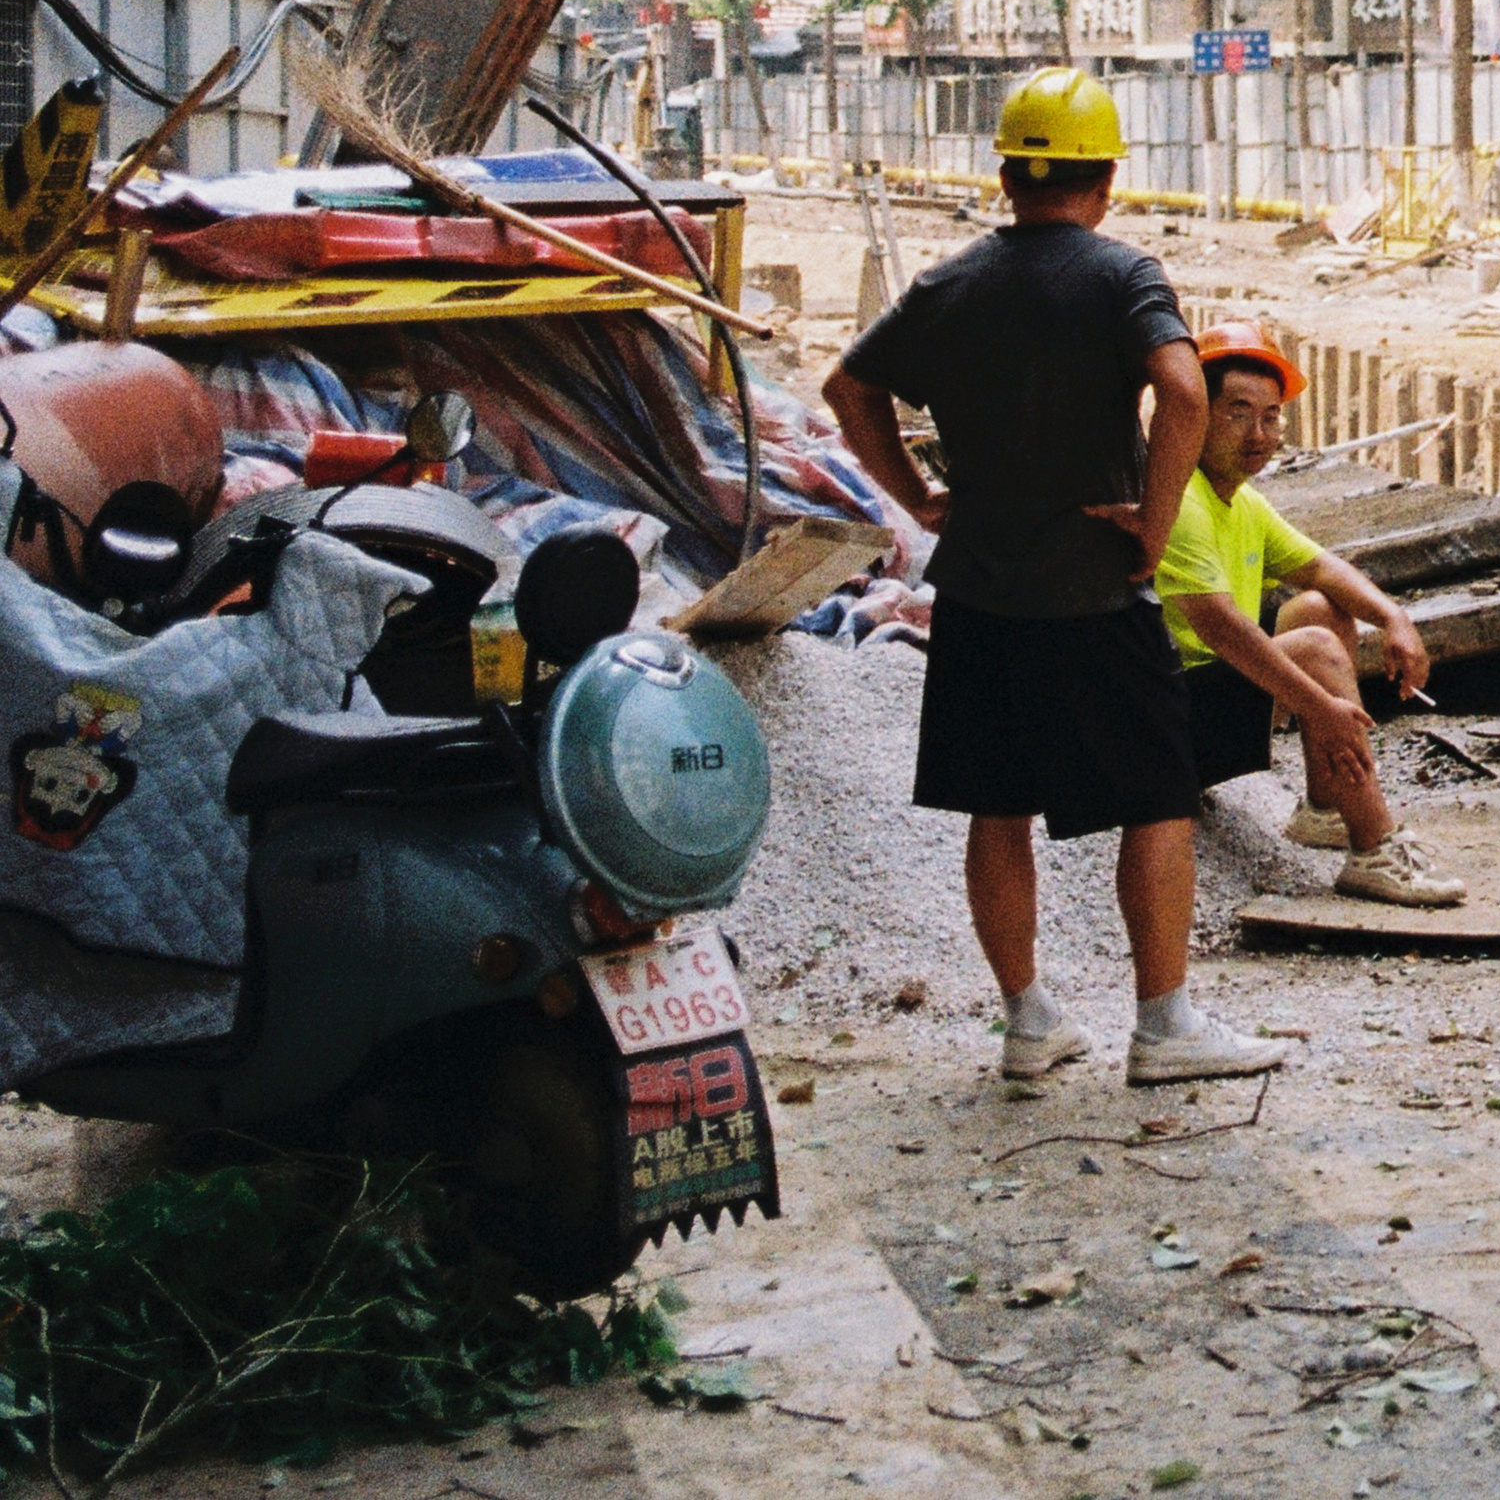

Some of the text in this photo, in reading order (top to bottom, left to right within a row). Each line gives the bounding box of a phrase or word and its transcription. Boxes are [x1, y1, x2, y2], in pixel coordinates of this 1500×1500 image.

[670, 743, 724, 774] 新日
[616, 984, 743, 1042] G1963
[626, 1045, 748, 1137] 新日
[632, 1109, 755, 1165] A股上市
